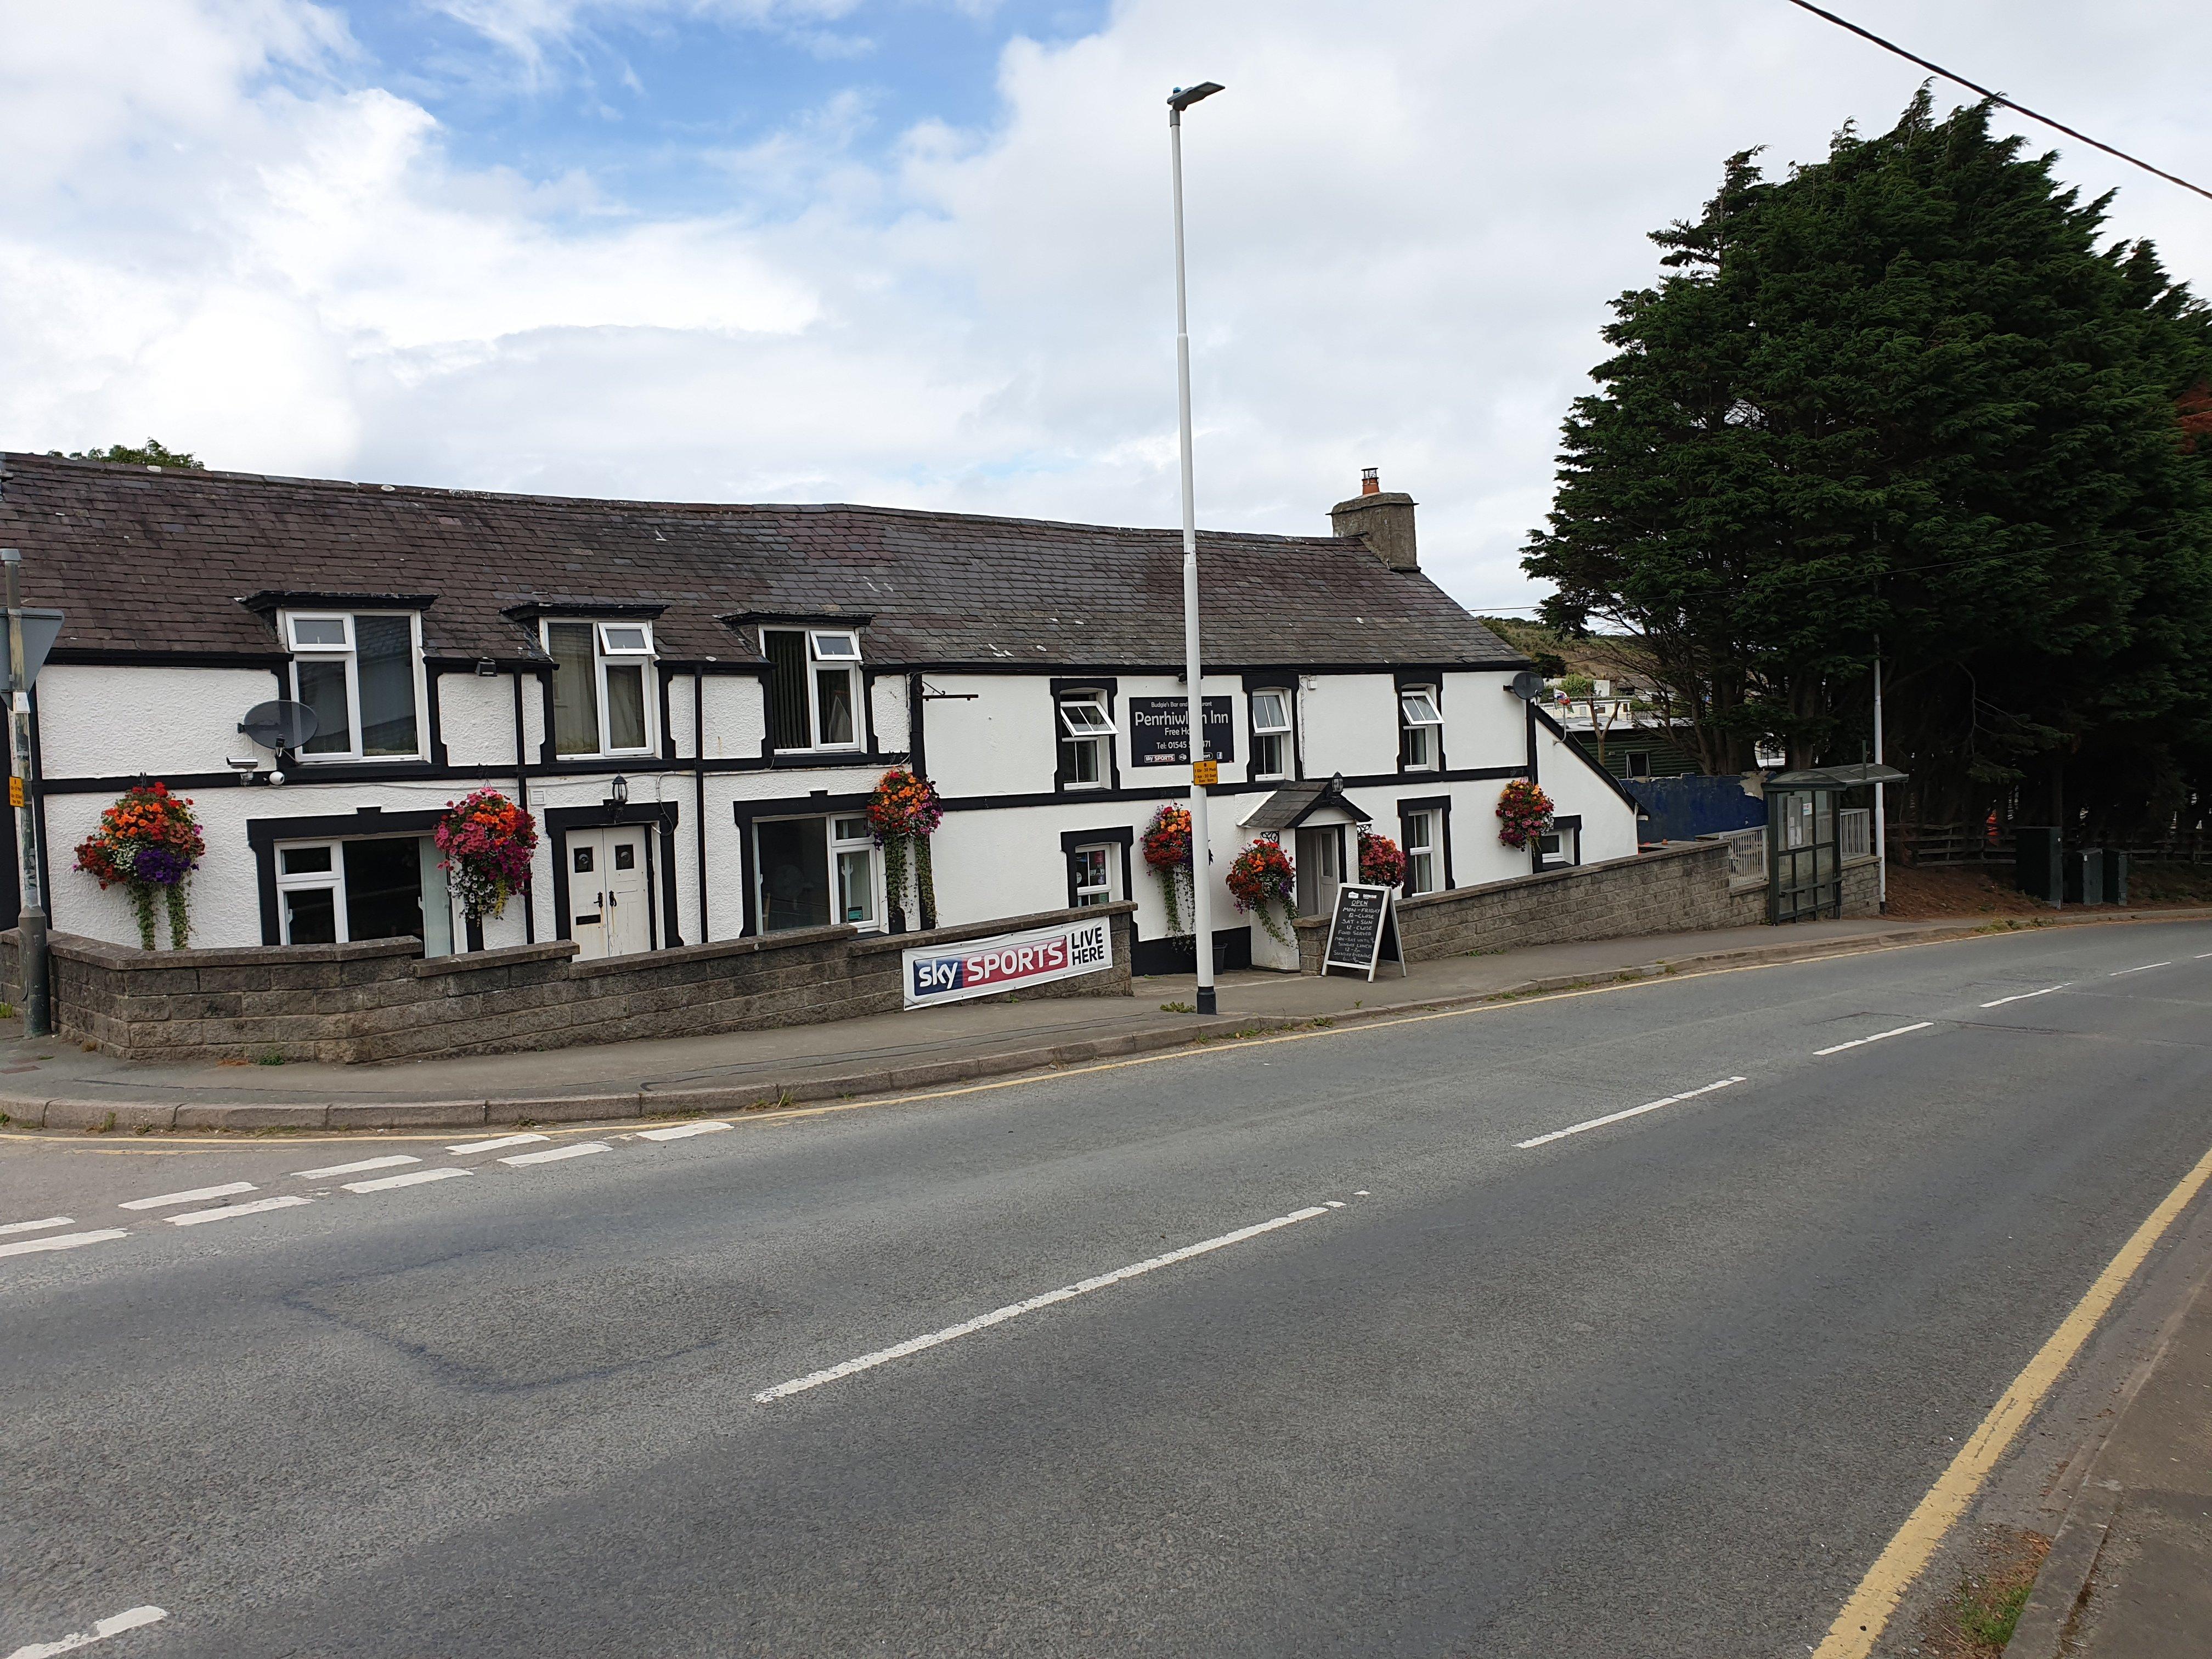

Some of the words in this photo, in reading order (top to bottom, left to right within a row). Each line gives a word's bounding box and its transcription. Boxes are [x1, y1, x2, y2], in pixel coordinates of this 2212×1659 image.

[1135, 710, 1207, 726] Penrhiwln
[1211, 710, 1229, 724] Inn
[1168, 741, 1187, 749] 01545
[1071, 927, 1103, 950] LIVE
[918, 957, 958, 989] sky
[967, 941, 1063, 981] SPORTS
[1071, 944, 1105, 966] HERE
